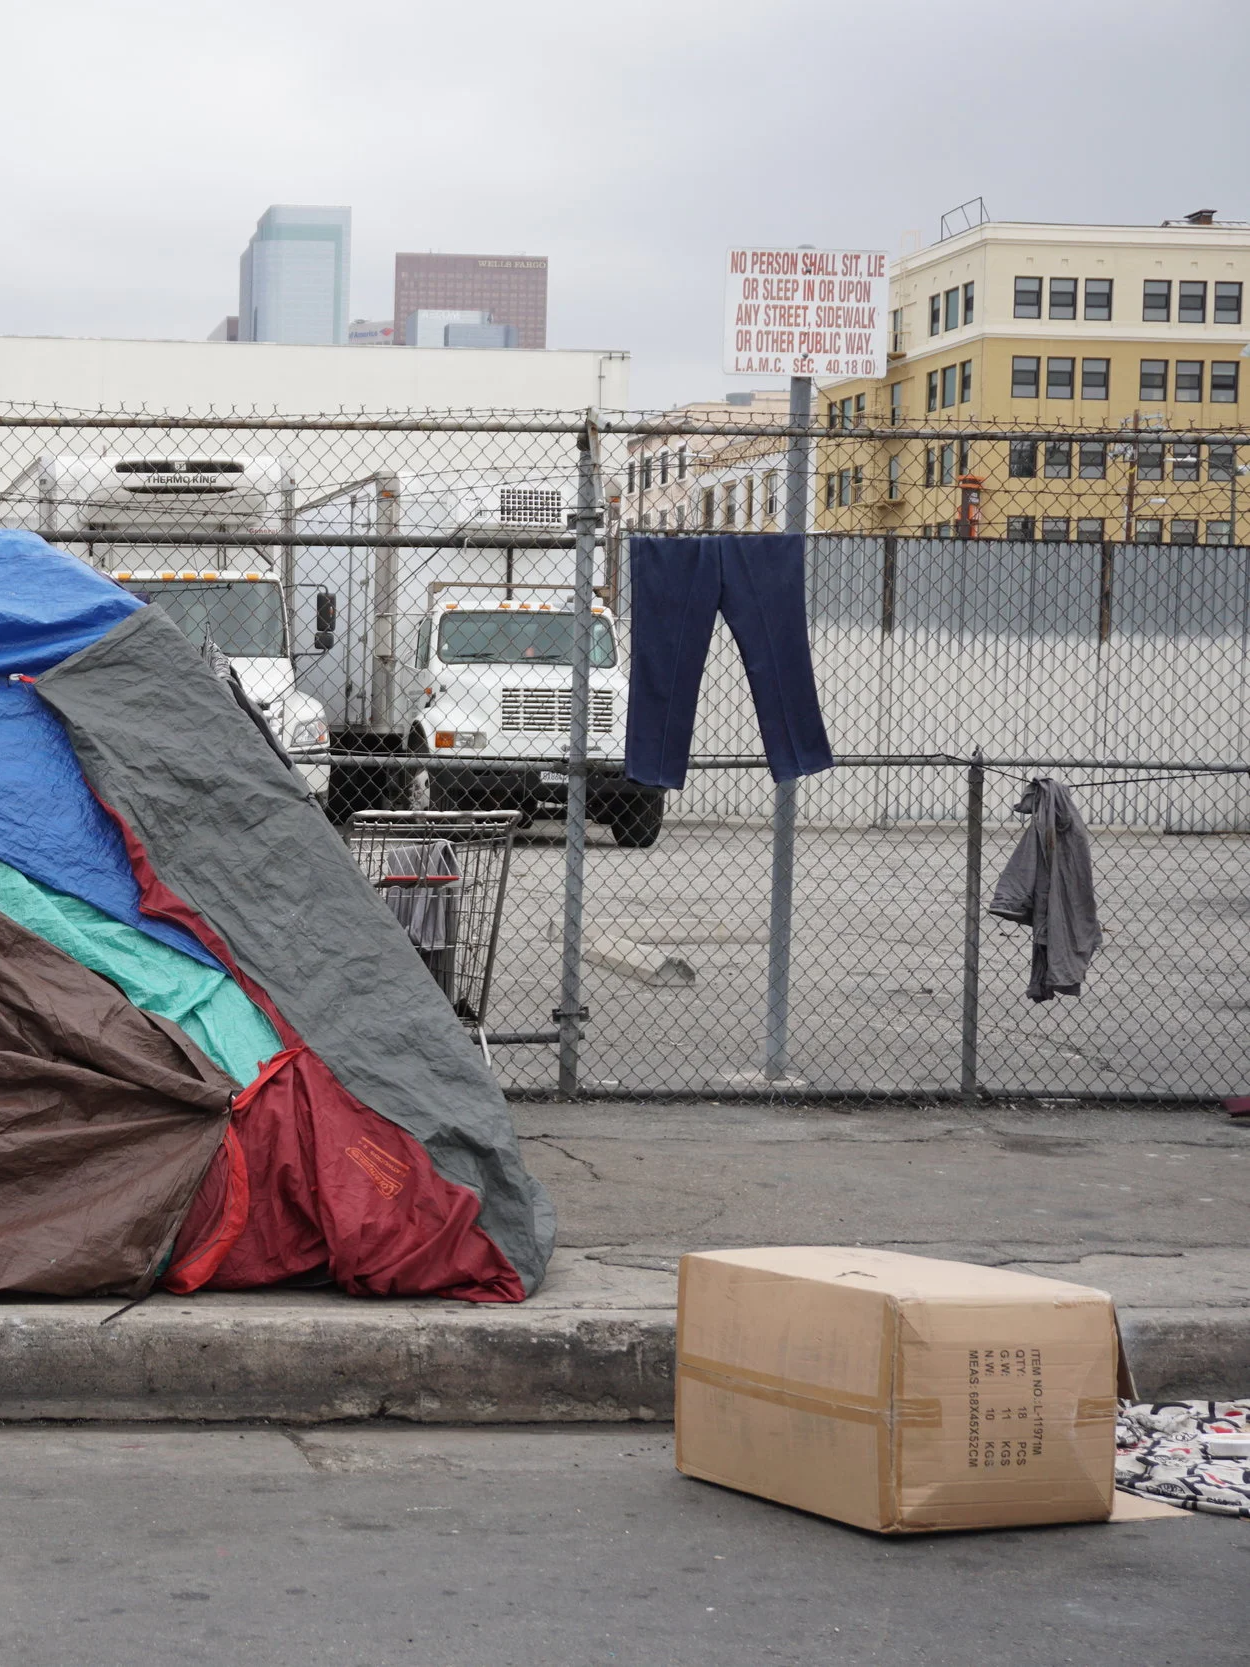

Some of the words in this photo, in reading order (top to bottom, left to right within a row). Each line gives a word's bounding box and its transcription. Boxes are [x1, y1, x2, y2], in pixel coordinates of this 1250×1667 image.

[478, 260, 512, 268] WELLS
[514, 261, 547, 269] FARGO
[731, 251, 747, 274] NO
[751, 252, 798, 275] PERSON
[801, 253, 838, 276] SHALL
[841, 254, 863, 279] SIT,
[867, 255, 885, 277] LIE
[742, 277, 758, 300] OR
[762, 278, 799, 301] SLEEP
[803, 279, 815, 302] IN
[818, 279, 835, 302] OR
[838, 280, 871, 303] UPON
[735, 303, 760, 326] ANY
[763, 304, 811, 329] STREET,
[815, 306, 876, 329] SIDEWALK
[735, 330, 752, 352] OR
[755, 330, 795, 353] OTHER
[798, 331, 841, 354] PUBLIC
[845, 332, 874, 356] WAY.
[735, 356, 786, 373] L.A.M.C.
[792, 358, 819, 374] SEC.
[825, 359, 858, 375] 40.18
[861, 359, 876, 375] (D)
[147, 475, 190, 484] THERMO
[193, 475, 217, 484] KING
[969, 1349, 980, 1389] MEAS:
[1015, 1349, 1026, 1377] QTY:
[1031, 1348, 1041, 1376] ITEM
[985, 1407, 995, 1421] 10
[1001, 1407, 1012, 1420] 11
[1017, 1406, 1027, 1419] 18
[968, 1391, 980, 1468] 68X45X52CM
[984, 1441, 995, 1467] KGS
[1000, 1441, 1011, 1467] KGS
[1016, 1441, 1027, 1466] PCS
